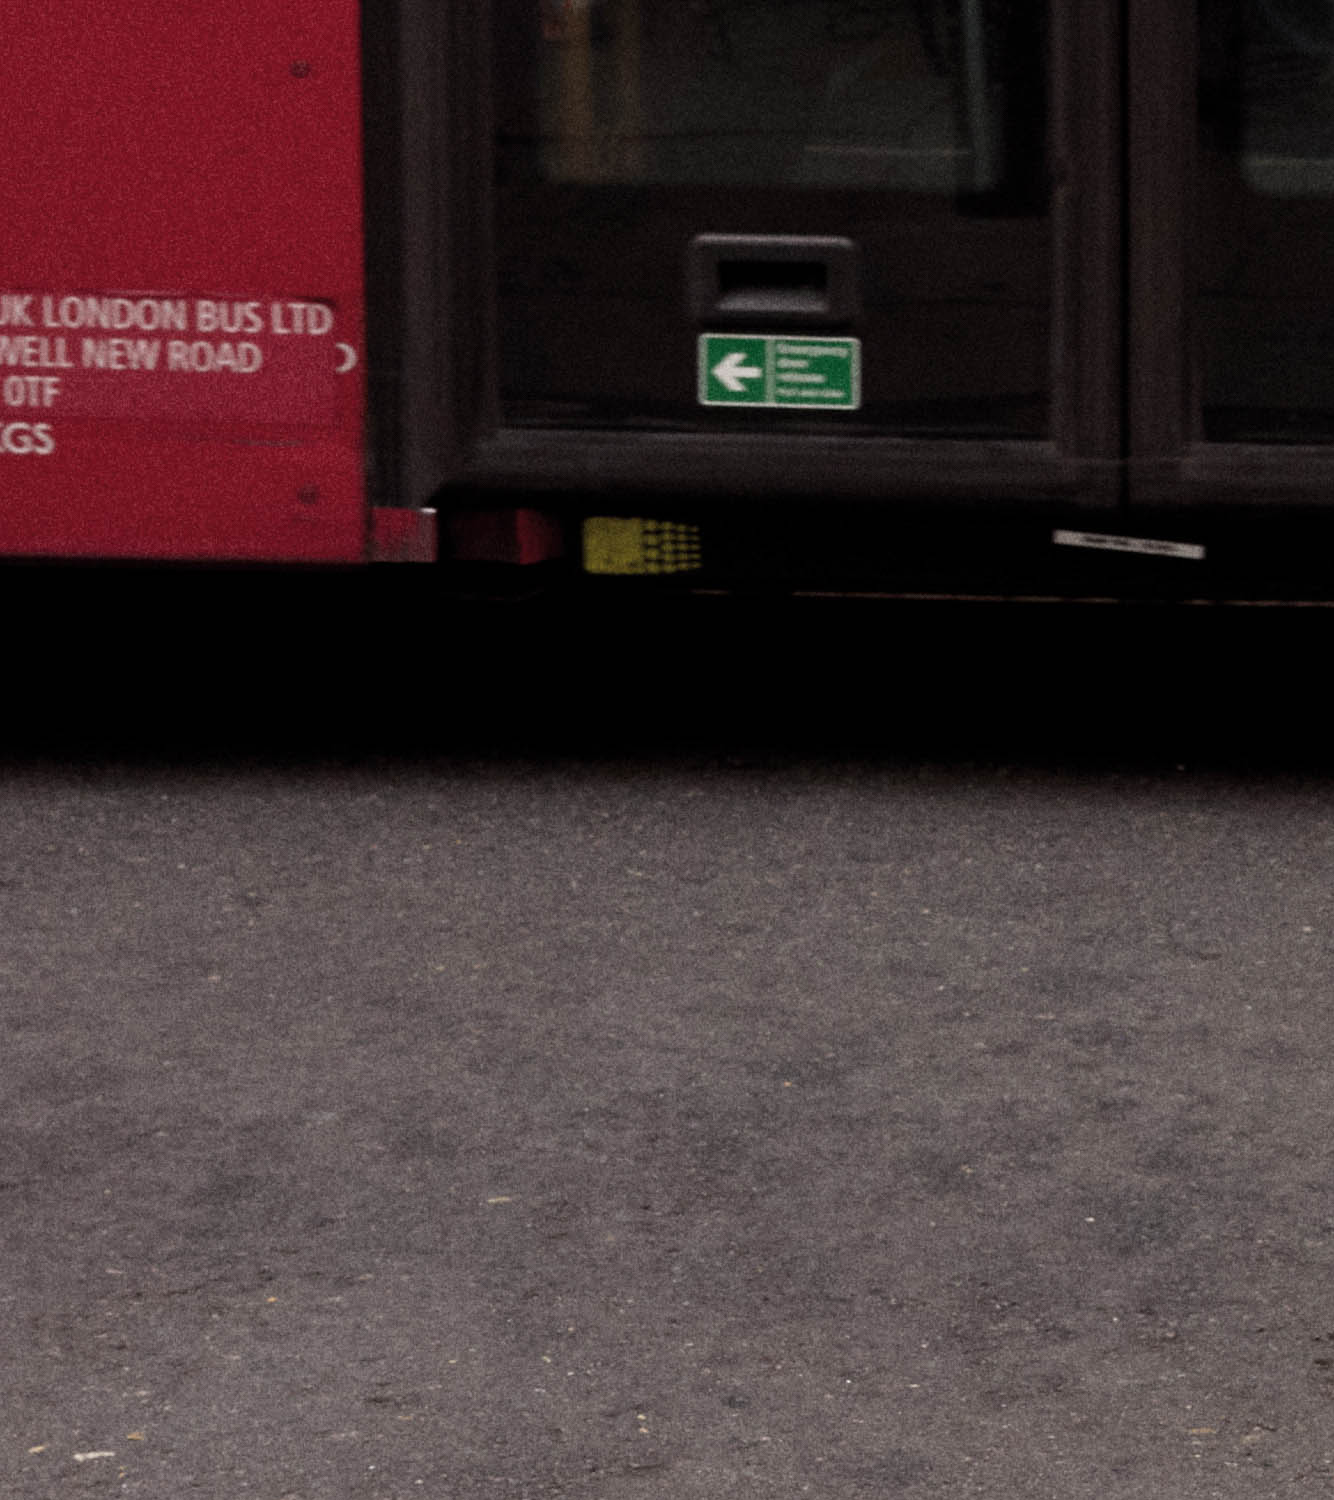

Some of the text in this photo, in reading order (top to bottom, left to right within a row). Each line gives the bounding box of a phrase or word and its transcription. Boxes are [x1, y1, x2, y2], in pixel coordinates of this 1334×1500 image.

[42, 295, 188, 331] LONDON
[196, 299, 264, 334] BUS
[270, 302, 335, 336] LTD
[81, 336, 162, 371] NEW
[167, 340, 264, 374] ROAD
[0, 420, 55, 456] GS
